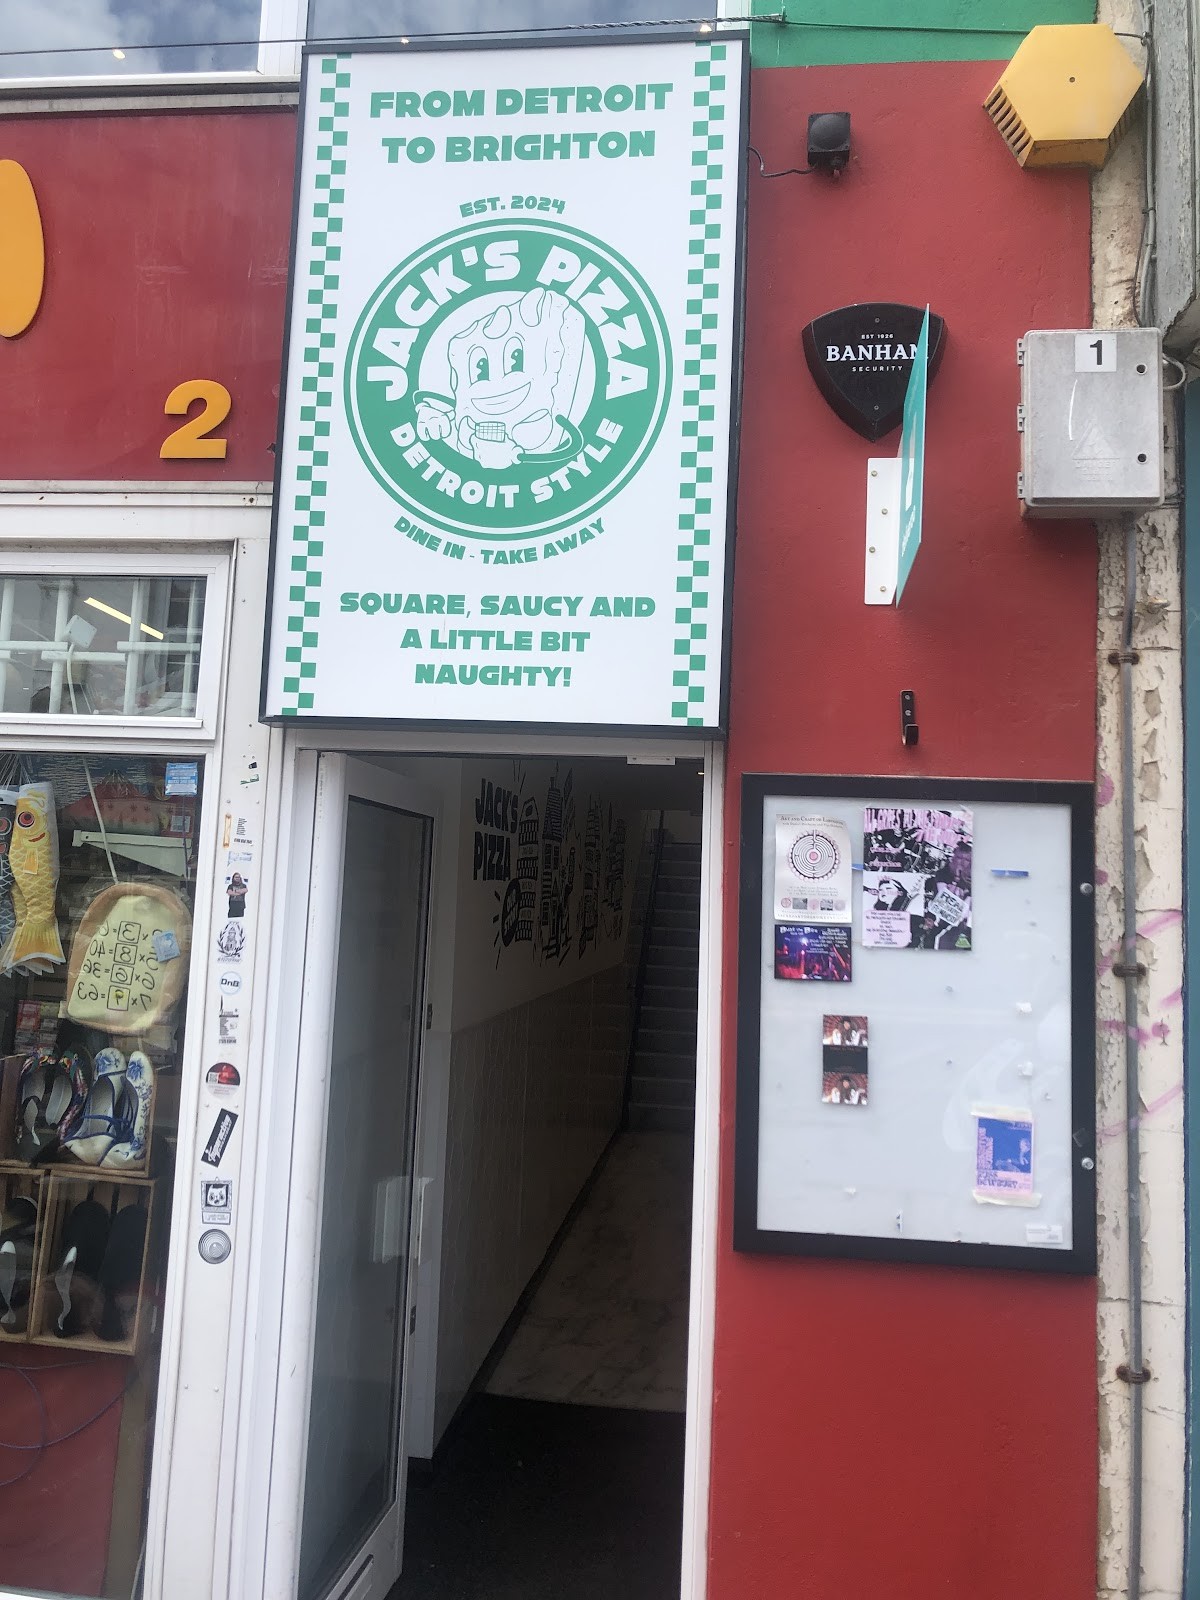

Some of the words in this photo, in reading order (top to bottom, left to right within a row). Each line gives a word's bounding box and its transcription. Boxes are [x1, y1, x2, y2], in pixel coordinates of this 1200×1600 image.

[371, 91, 484, 117] FROM
[496, 83, 673, 115] DETROIT
[382, 136, 435, 163] TO
[446, 131, 656, 162] BRIGHTON
[460, 197, 506, 218] EST.
[511, 196, 565, 214] 2024
[367, 240, 521, 402] JACK'S
[536, 245, 649, 400] PIZZA
[1089, 339, 1104, 366] 1
[160, 379, 232, 458] 2
[390, 421, 520, 508] DETROIT
[529, 417, 624, 503] STYLE
[393, 515, 442, 551] DINE
[443, 542, 466, 560] IN
[481, 546, 538, 565] TAKE
[543, 517, 606, 558] AWAY
[340, 592, 471, 619] SQUARE,
[480, 593, 584, 617] SAUCY
[589, 596, 656, 618] AND
[400, 629, 422, 649] A
[430, 629, 533, 651] LITTLE
[540, 630, 591, 653] BIT
[414, 663, 572, 688] NAUGHTY!
[475, 778, 519, 834] JACK'S
[473, 831, 511, 881] PIZZA
